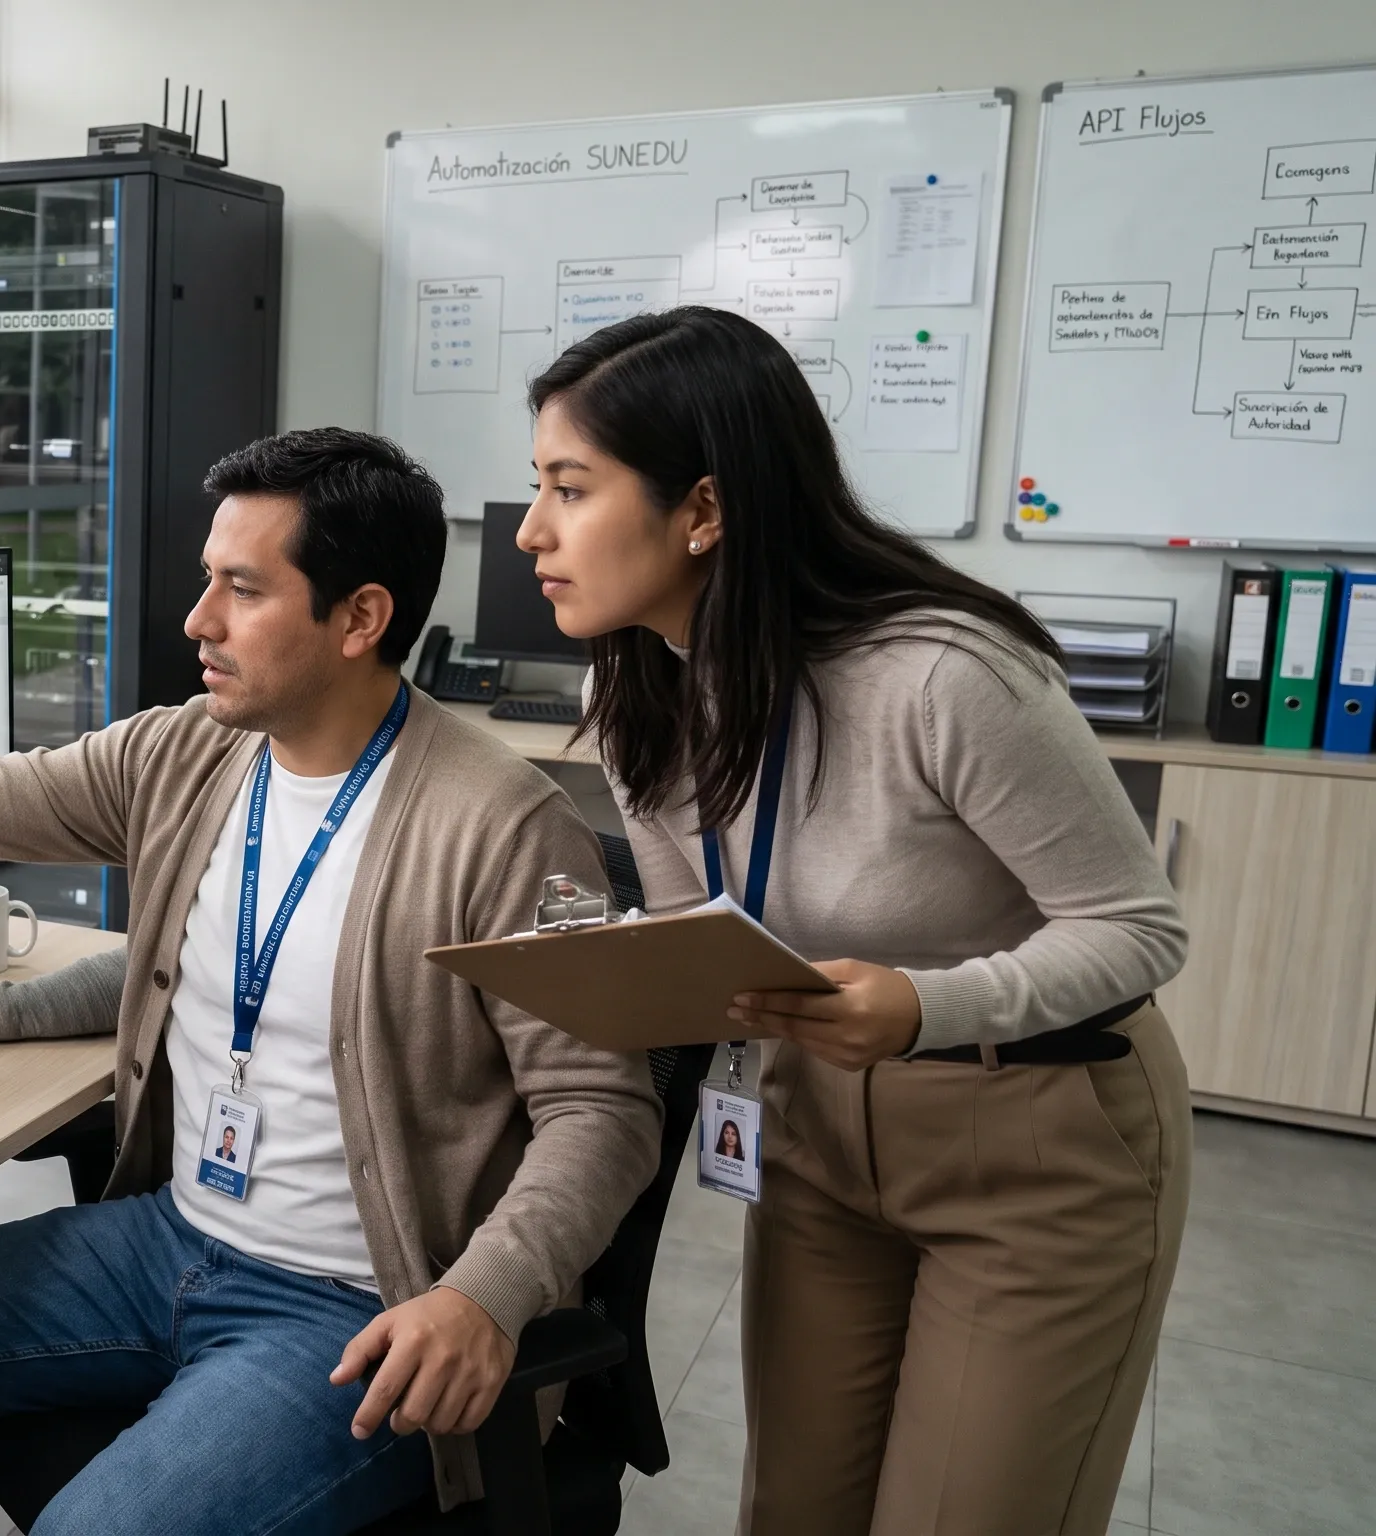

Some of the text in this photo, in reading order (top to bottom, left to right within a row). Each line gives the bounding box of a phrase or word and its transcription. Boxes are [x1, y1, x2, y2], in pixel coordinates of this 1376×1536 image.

[1078, 104, 1206, 137] API Flujos
[427, 139, 688, 182] Automatización SUNEDU
[1290, 305, 1329, 324] Flujos
[1314, 401, 1329, 413] de
